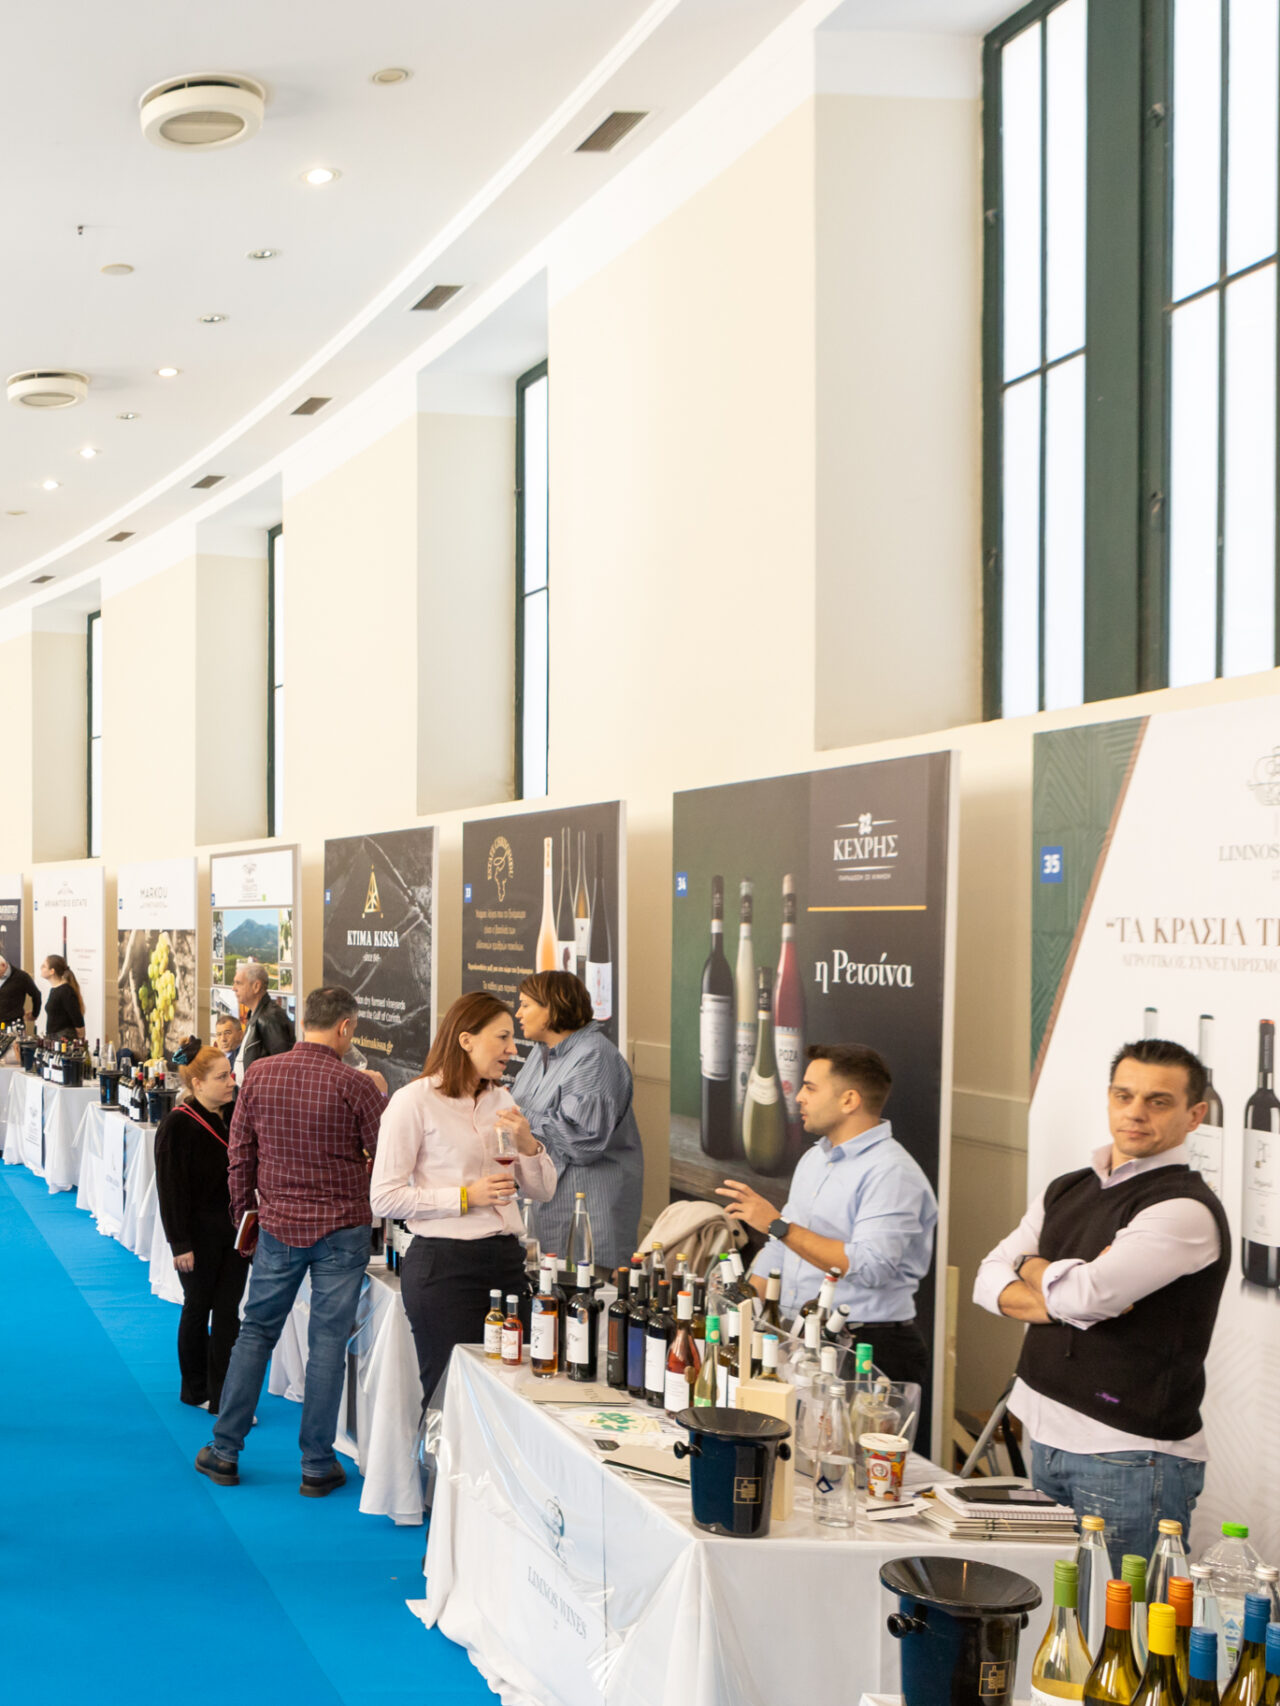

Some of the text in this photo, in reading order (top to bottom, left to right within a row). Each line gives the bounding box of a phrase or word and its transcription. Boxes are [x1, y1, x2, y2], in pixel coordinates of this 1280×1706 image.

[833, 834, 898, 861] ΚΕΧΡΗΣ
[1218, 844, 1280, 862] LIMNOS
[1043, 853, 1061, 874] 35
[140, 886, 168, 899] MARKOU
[676, 875, 688, 891] 34
[347, 930, 400, 948] KTIMA KISSA
[1154, 917, 1247, 946] ΚΡΑΣΙΑ
[814, 949, 915, 994] η Ρετσίνα
[527, 1565, 587, 1641] LIMNOS WINES
